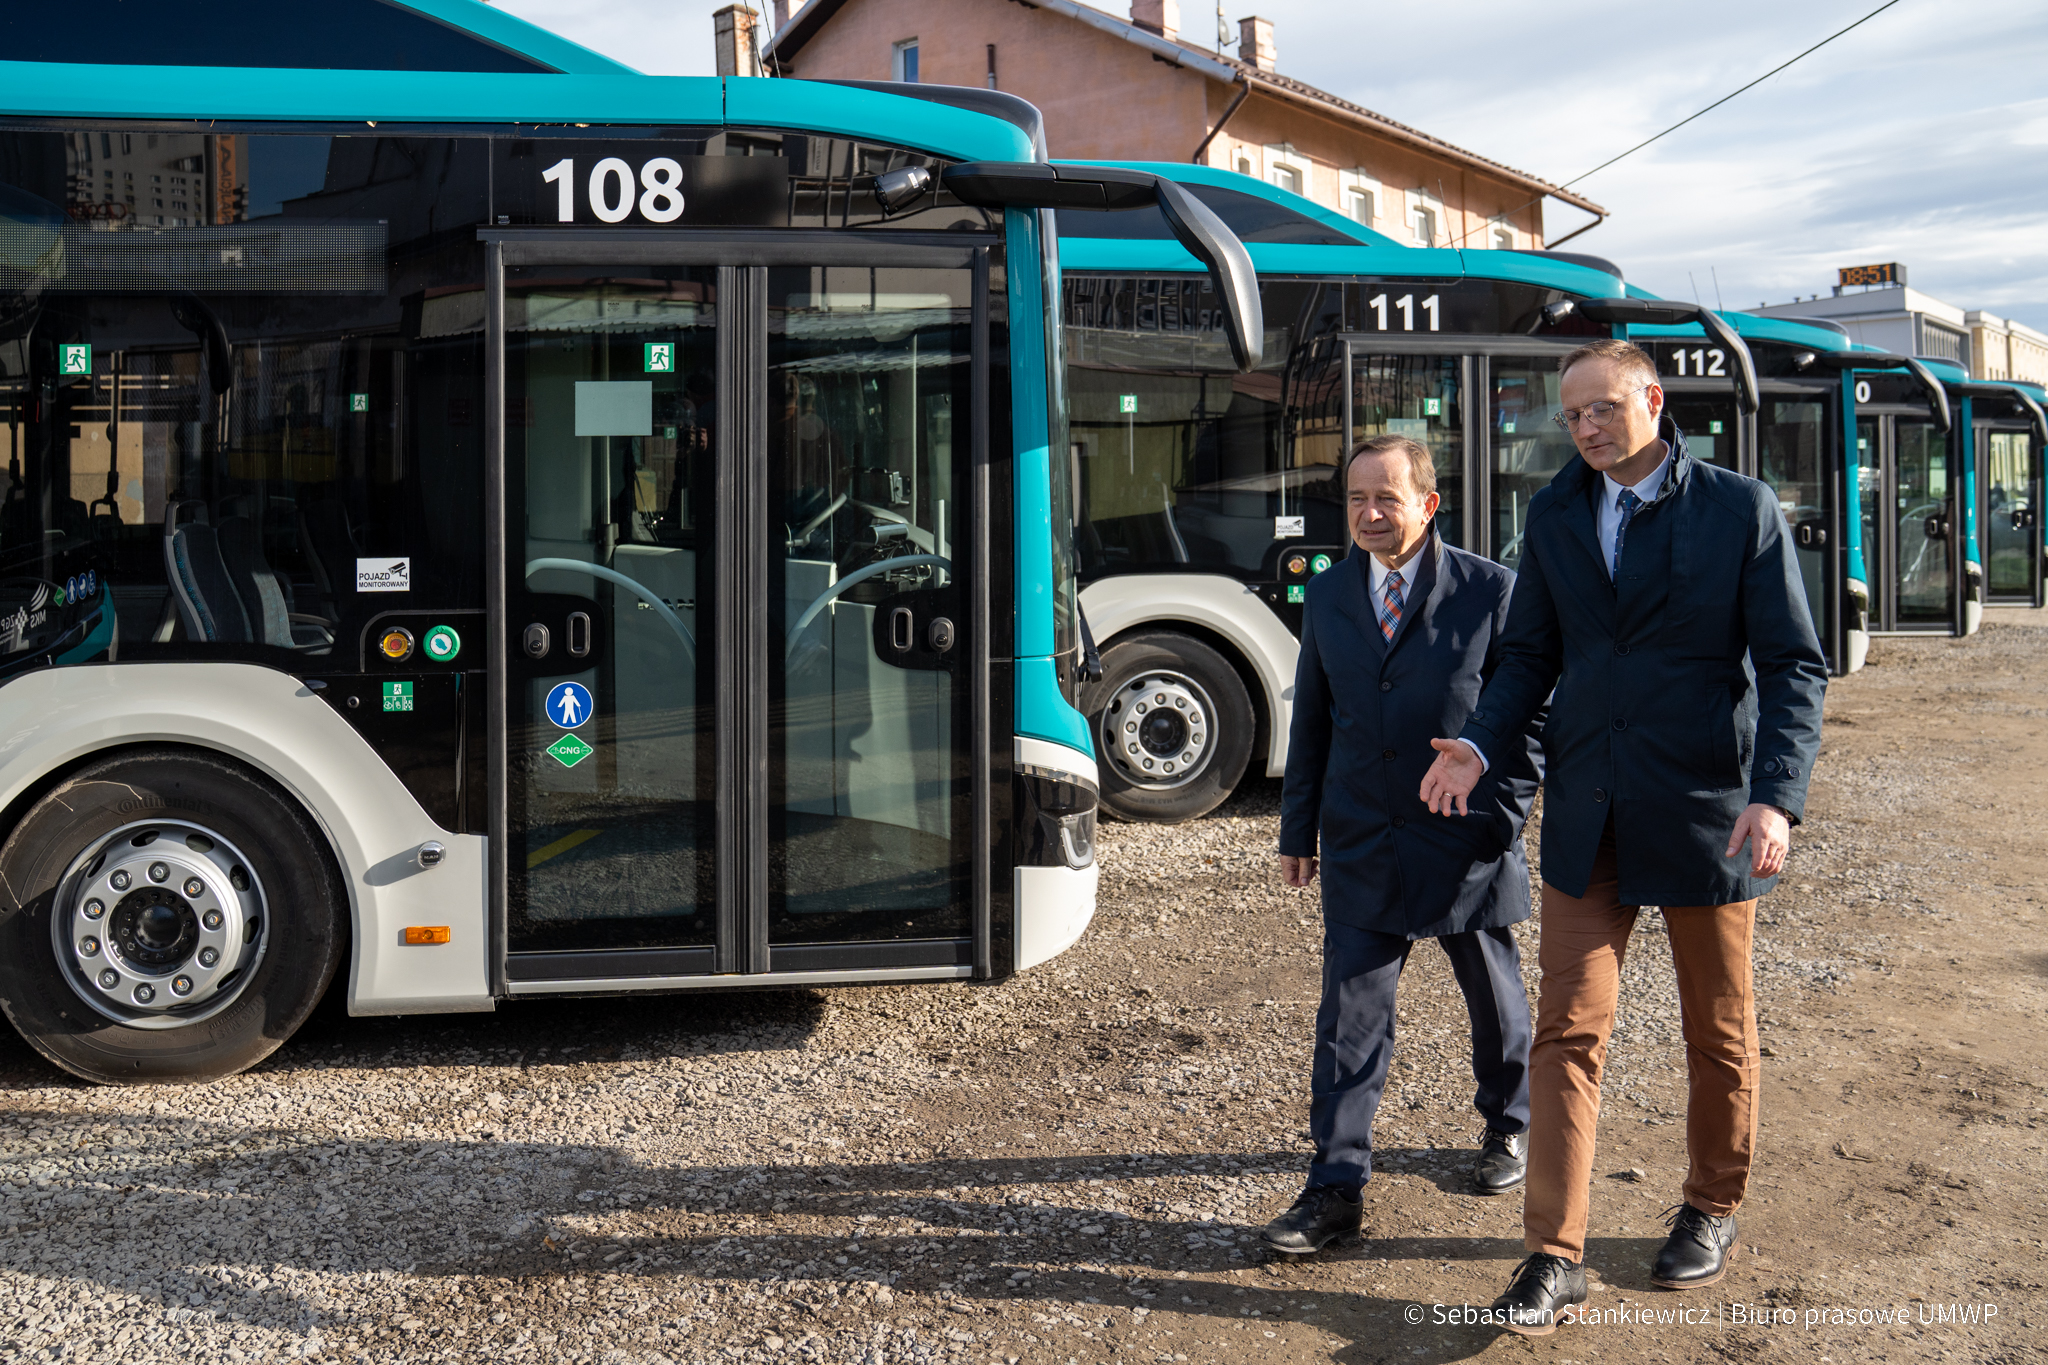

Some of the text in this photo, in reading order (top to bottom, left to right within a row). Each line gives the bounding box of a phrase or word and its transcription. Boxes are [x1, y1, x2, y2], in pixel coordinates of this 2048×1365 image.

[542, 157, 685, 223] 108
[1840, 264, 1891, 286] 08:51
[1369, 293, 1439, 331] 111
[1672, 348, 1726, 376] 112
[358, 572, 391, 581] POJAZD
[559, 746, 580, 755] CNG
[115, 795, 203, 816] Continental
